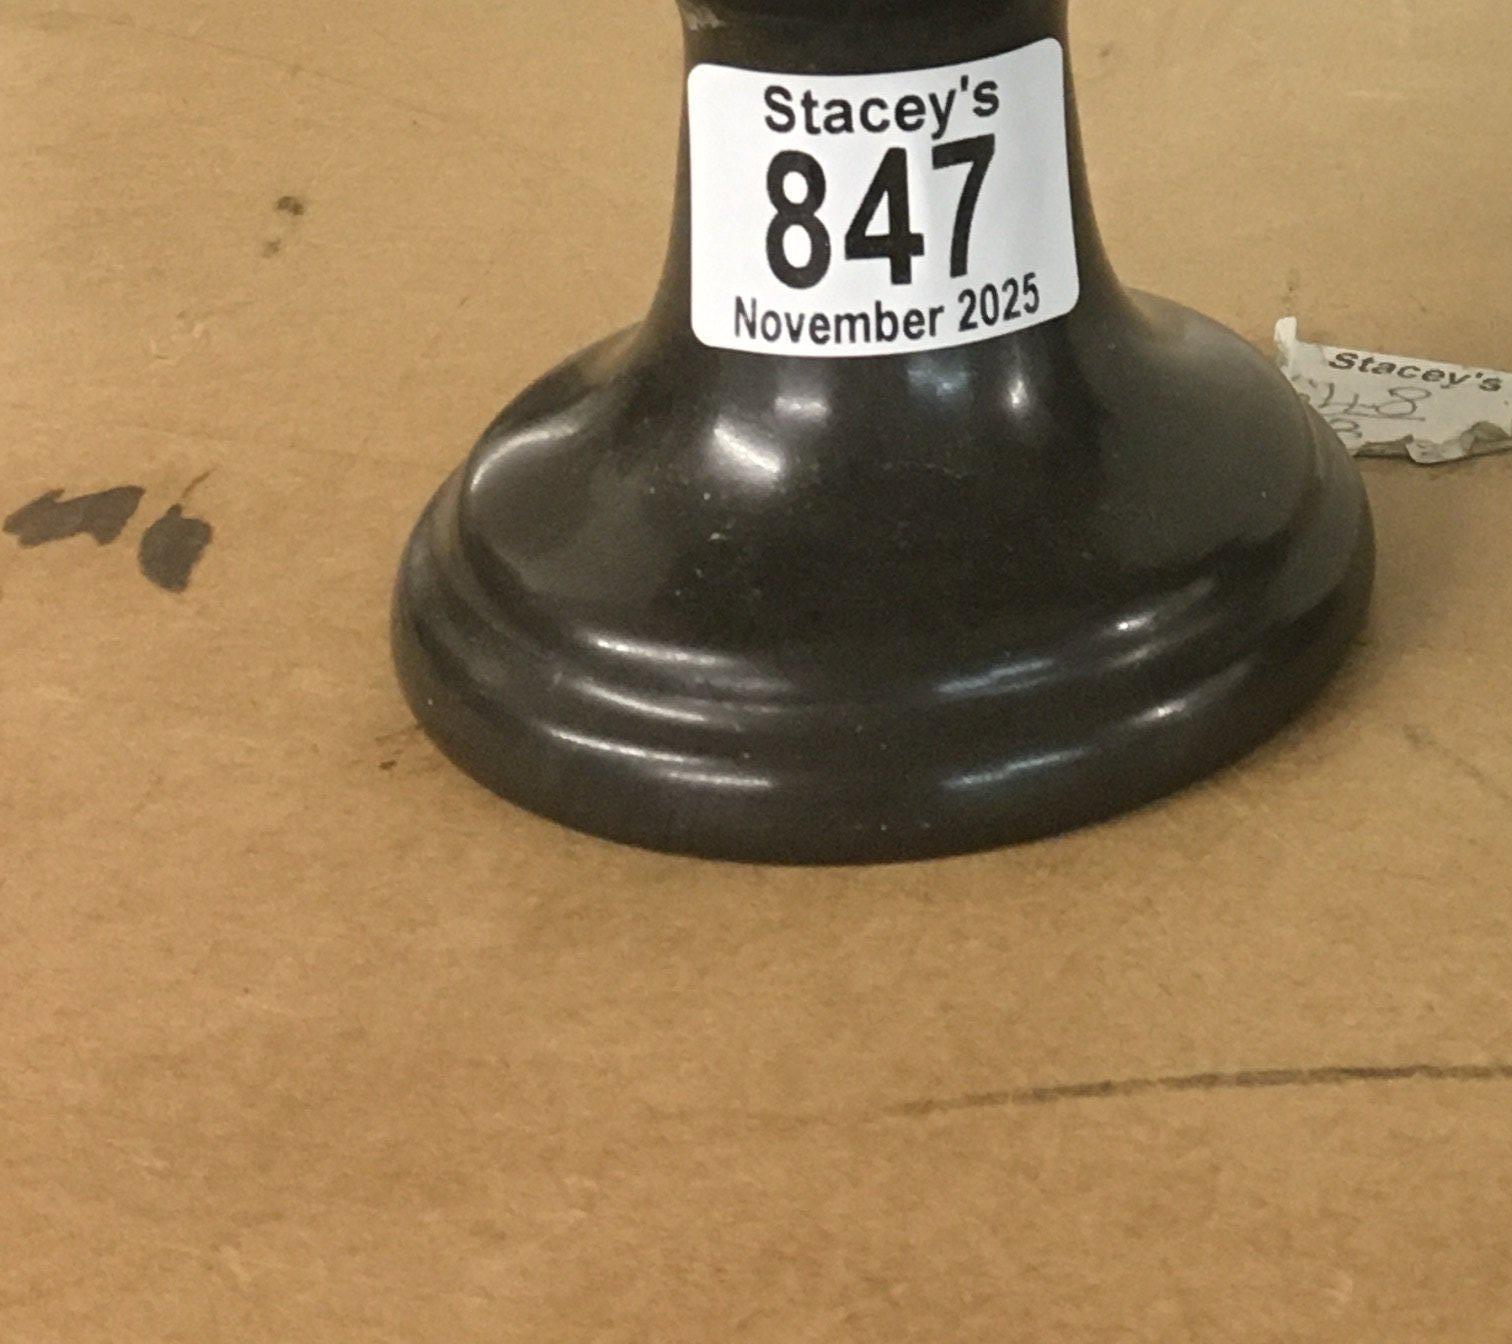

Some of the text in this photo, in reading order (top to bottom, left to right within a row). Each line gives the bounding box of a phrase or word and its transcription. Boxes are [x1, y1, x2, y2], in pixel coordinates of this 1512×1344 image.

[763, 74, 1000, 140] Stacey's
[765, 133, 996, 290] 847
[734, 272, 1041, 345] November 2025
[1328, 351, 1501, 392] Stacey's
